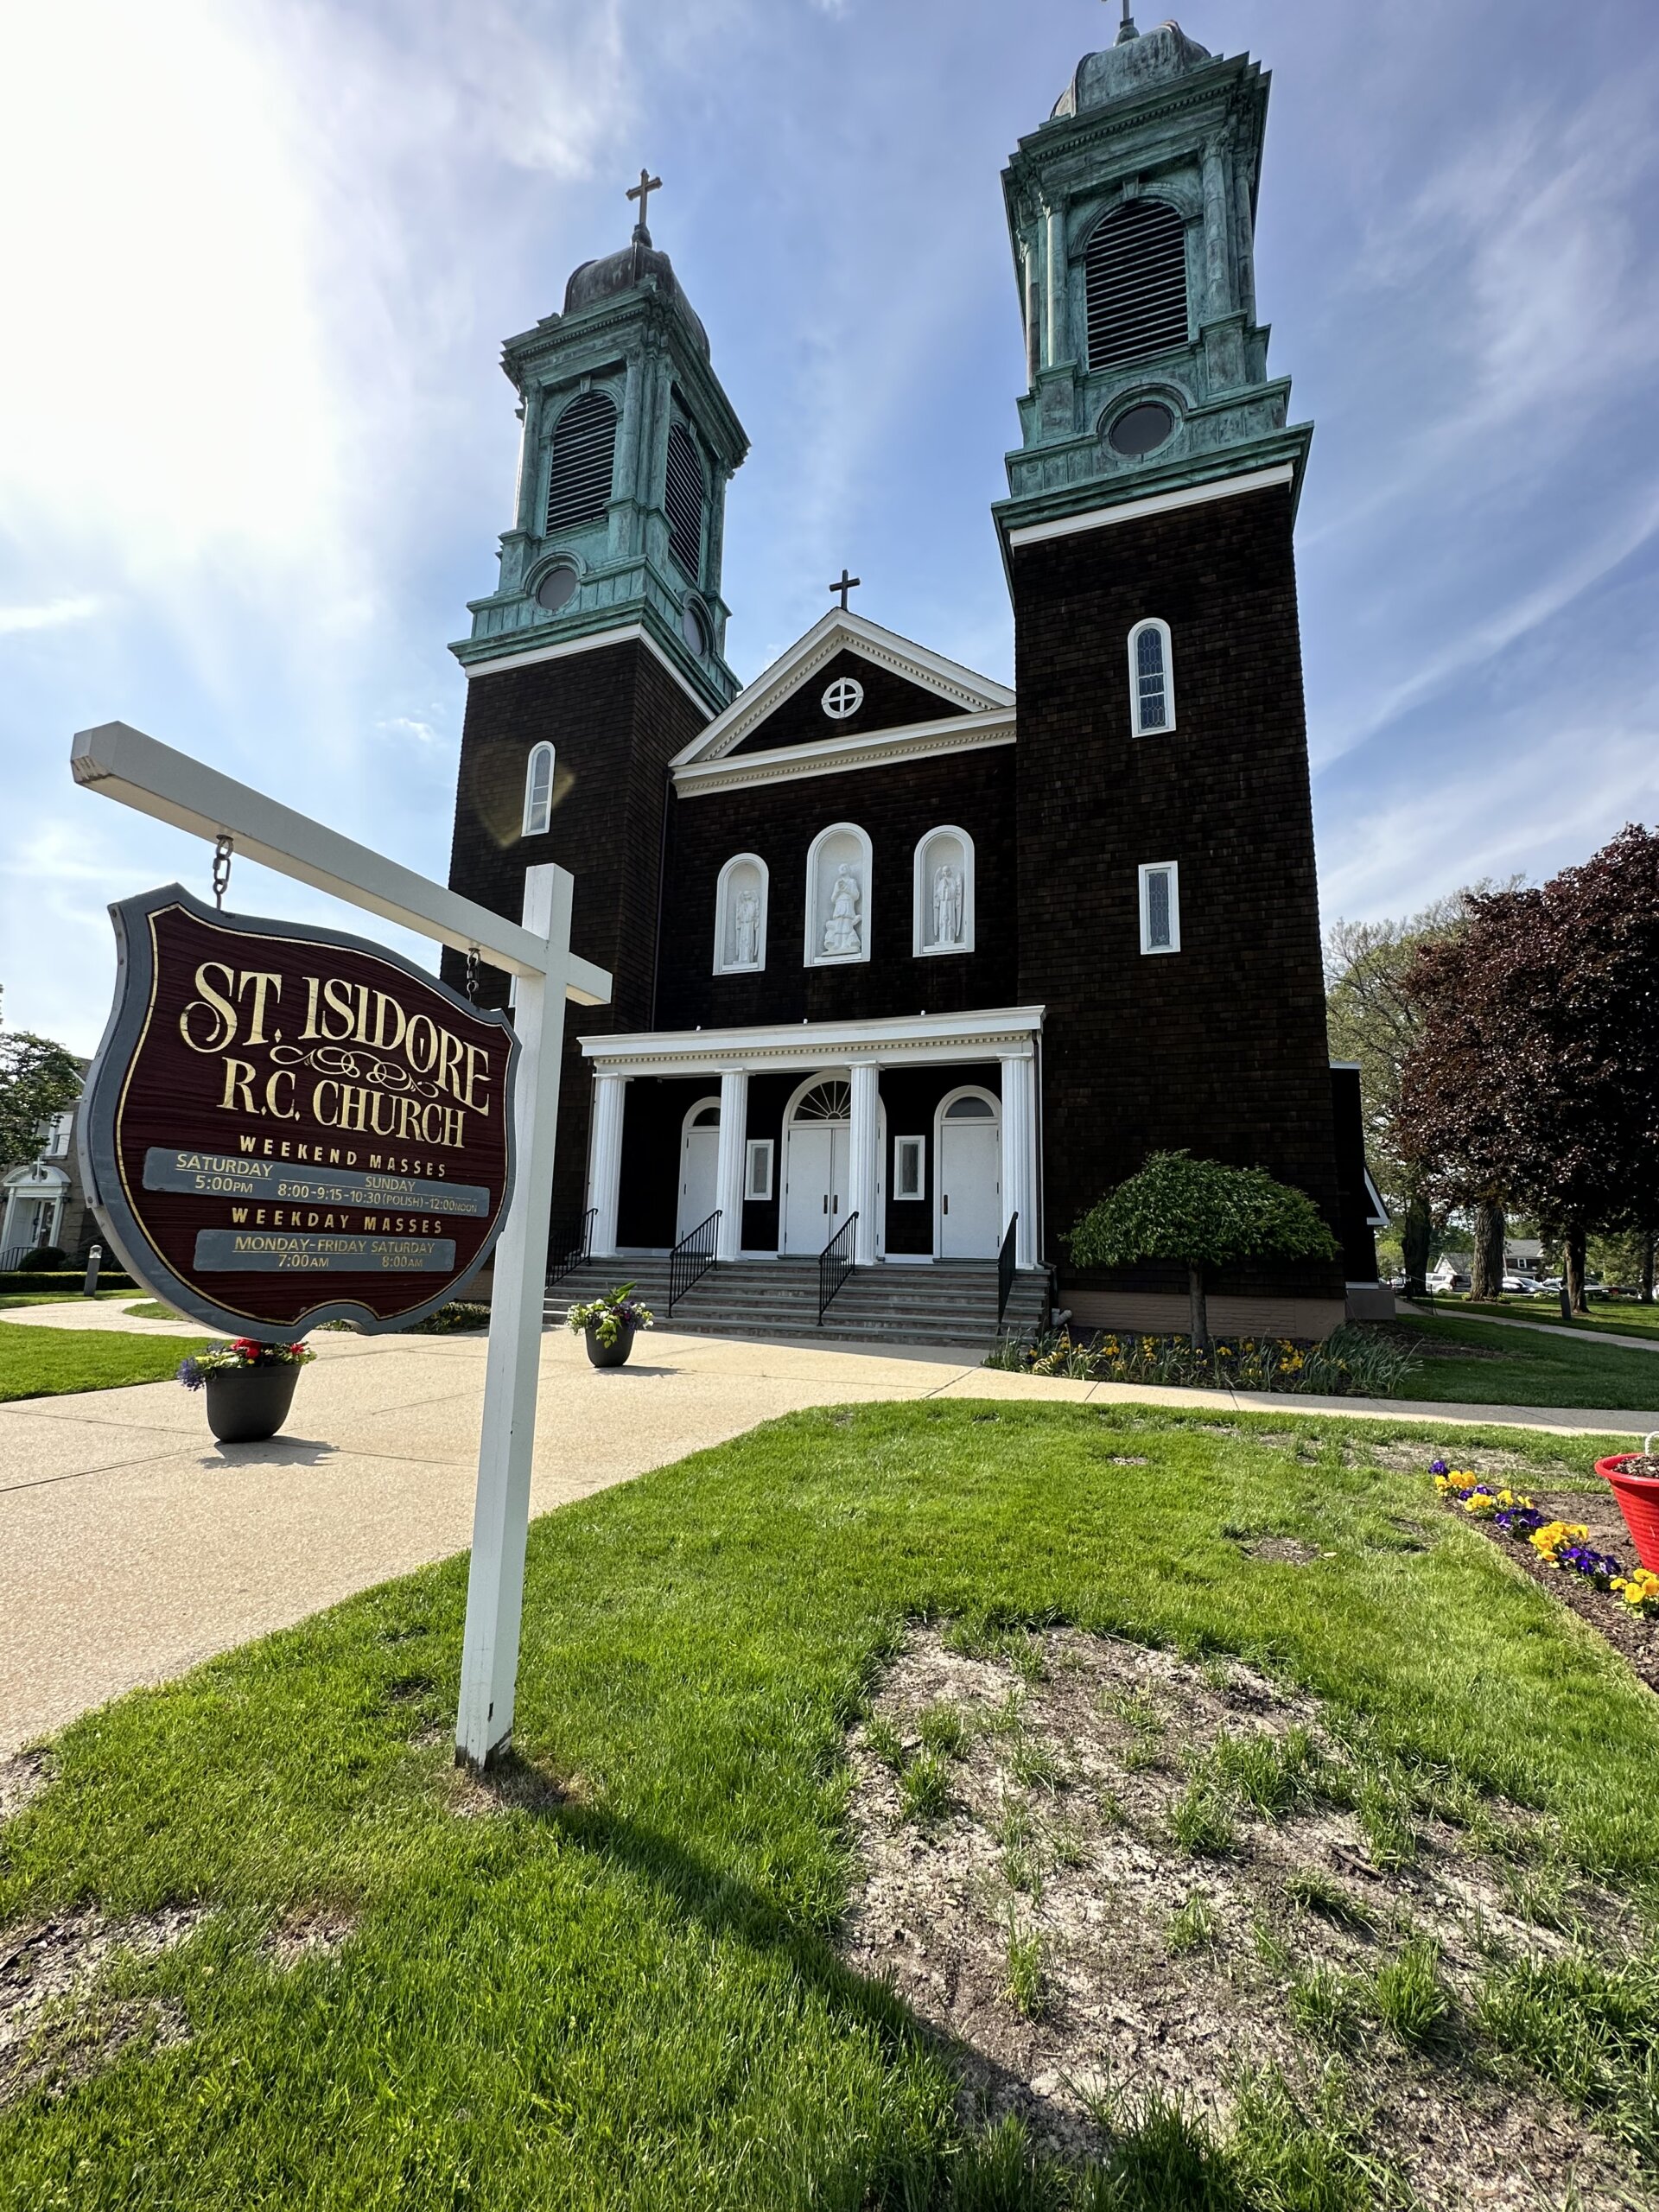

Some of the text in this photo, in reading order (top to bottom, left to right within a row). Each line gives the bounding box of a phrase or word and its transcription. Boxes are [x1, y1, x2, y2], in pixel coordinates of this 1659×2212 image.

[180, 962, 492, 1116] ST. ISIDORE
[216, 1056, 467, 1147] R.C. CHURCH
[175, 1153, 273, 1178] SATURDAY
[239, 1135, 446, 1178] WEEKEND MASSES
[194, 1175, 253, 1193] 5:00PM
[365, 1176, 416, 1192] SUNDAY
[232, 1207, 442, 1234] WEEKDAY MASSES
[234, 1236, 435, 1254] MONDAY-FRIDAY SATURDAY
